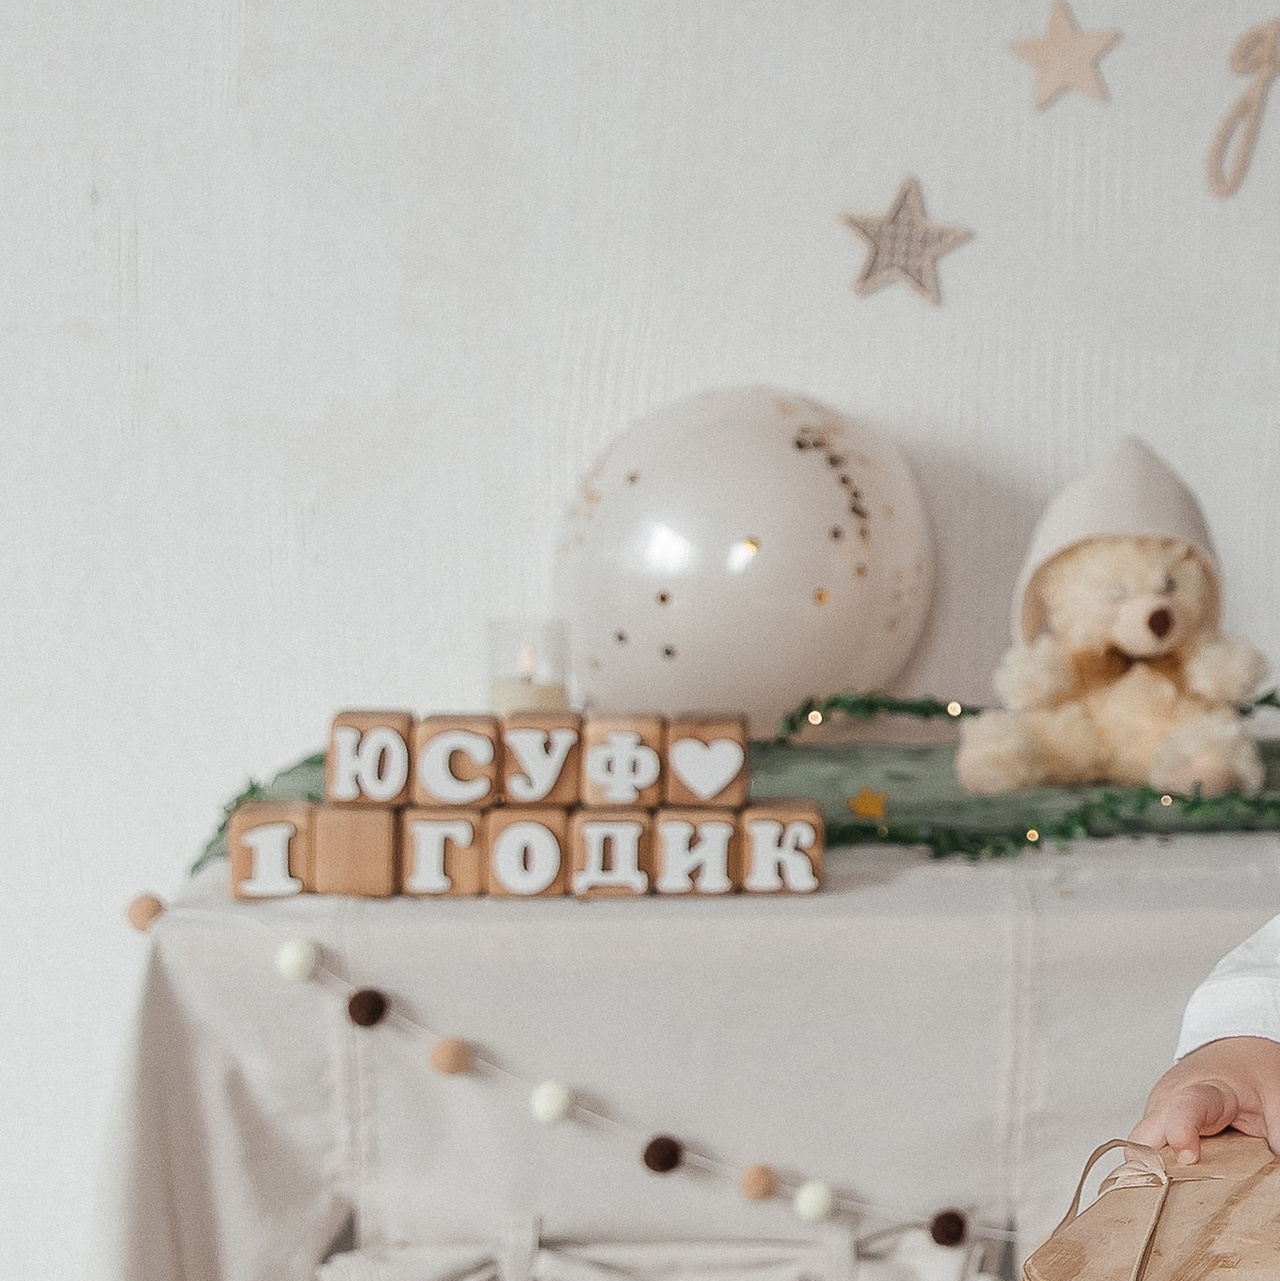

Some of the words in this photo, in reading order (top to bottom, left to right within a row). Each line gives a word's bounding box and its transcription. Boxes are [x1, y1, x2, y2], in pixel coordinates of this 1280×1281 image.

[332, 723, 661, 804] ЮСУФ
[240, 821, 305, 898] 1
[407, 819, 820, 897] ГОДИК
